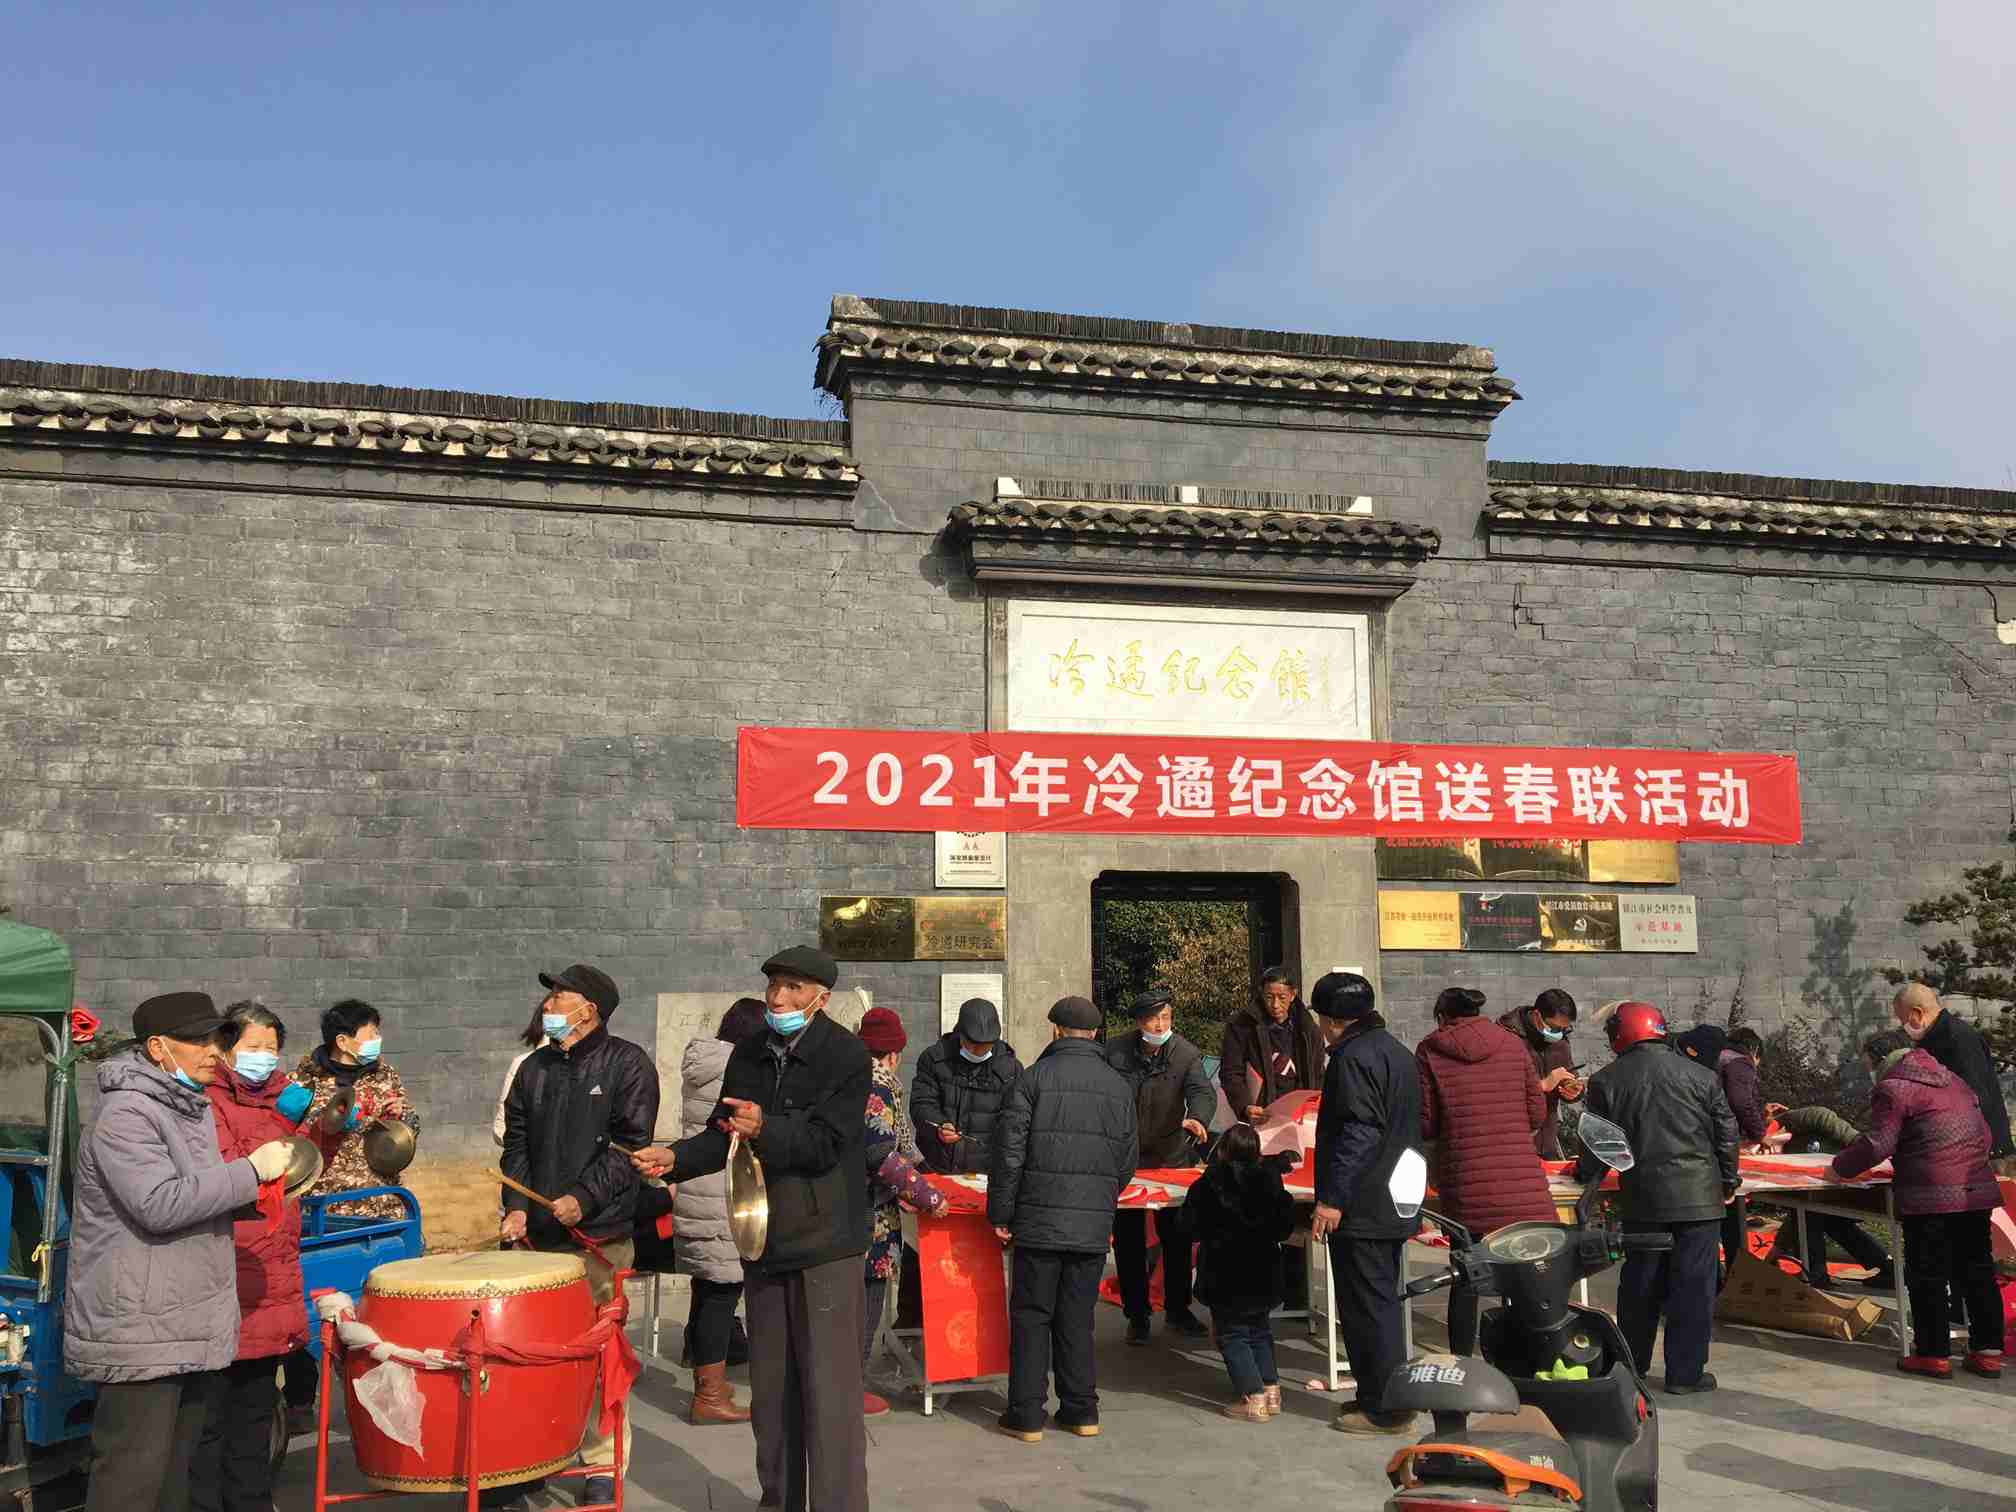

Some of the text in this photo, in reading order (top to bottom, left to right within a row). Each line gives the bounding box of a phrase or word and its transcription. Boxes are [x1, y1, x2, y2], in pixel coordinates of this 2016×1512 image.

[812, 750, 1750, 830] 2021年冷遹纪念馆送春联活动
[1407, 1364, 1467, 1386] 雅迪
